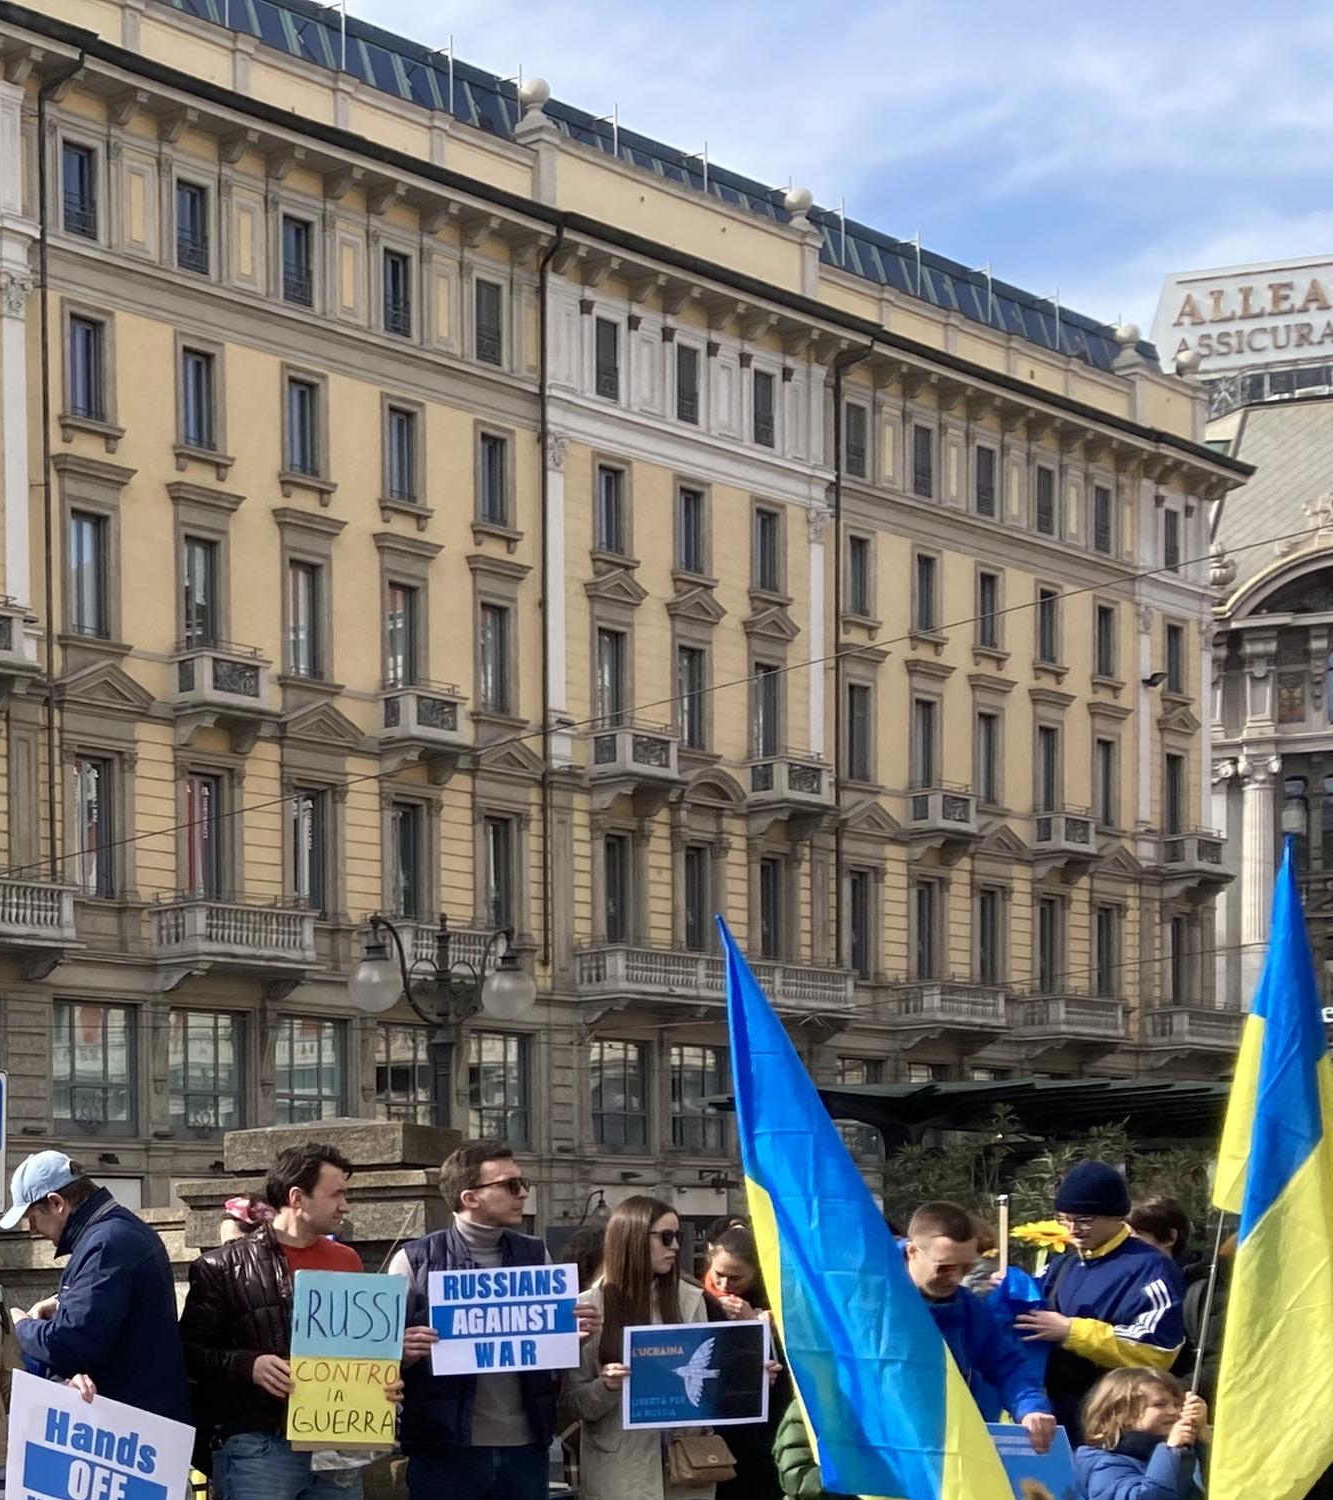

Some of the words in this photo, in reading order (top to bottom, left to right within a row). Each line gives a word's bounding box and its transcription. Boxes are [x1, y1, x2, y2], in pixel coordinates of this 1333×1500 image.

[443, 1268, 567, 1301] RUSSIANS
[307, 1289, 401, 1343] RUSSI
[452, 1303, 558, 1336] AGAINST
[474, 1340, 538, 1369] WAR
[296, 1362, 398, 1385] CONTRO
[292, 1407, 397, 1434] GUERRA
[44, 1407, 157, 1474] Hands
